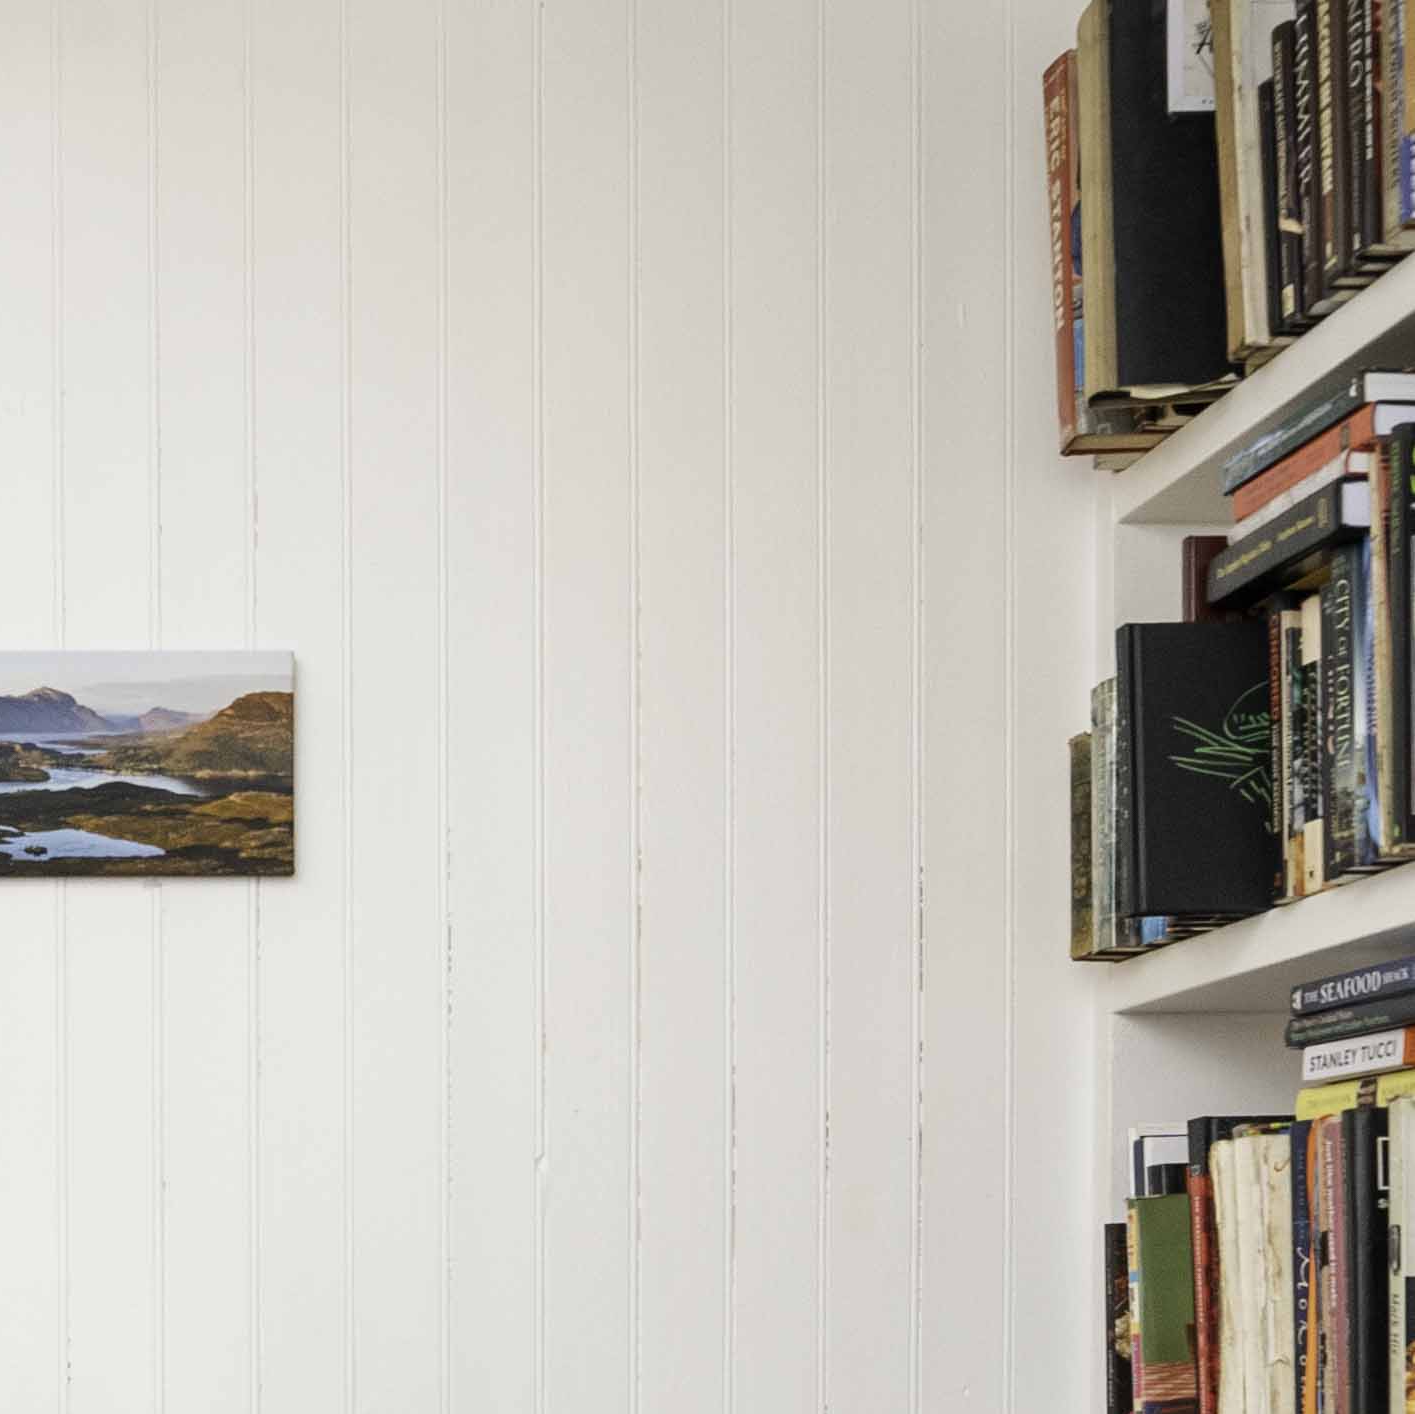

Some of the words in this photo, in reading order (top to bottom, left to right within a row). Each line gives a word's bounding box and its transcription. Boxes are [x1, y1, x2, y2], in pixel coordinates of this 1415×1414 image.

[1049, 97, 1061, 171] ERIC
[1051, 179, 1065, 329] STANTON
[1336, 580, 1351, 630] CITY
[1269, 614, 1281, 721] CENSORED
[1336, 663, 1351, 768] FORTUNE
[1320, 971, 1381, 1004] SEAFOOD
[1309, 1046, 1357, 1073] STANLEY
[1361, 1040, 1397, 1063] TUCCI
[1326, 1164, 1334, 1187] like
[1327, 1189, 1335, 1230] mother
[1329, 1276, 1337, 1308] make
